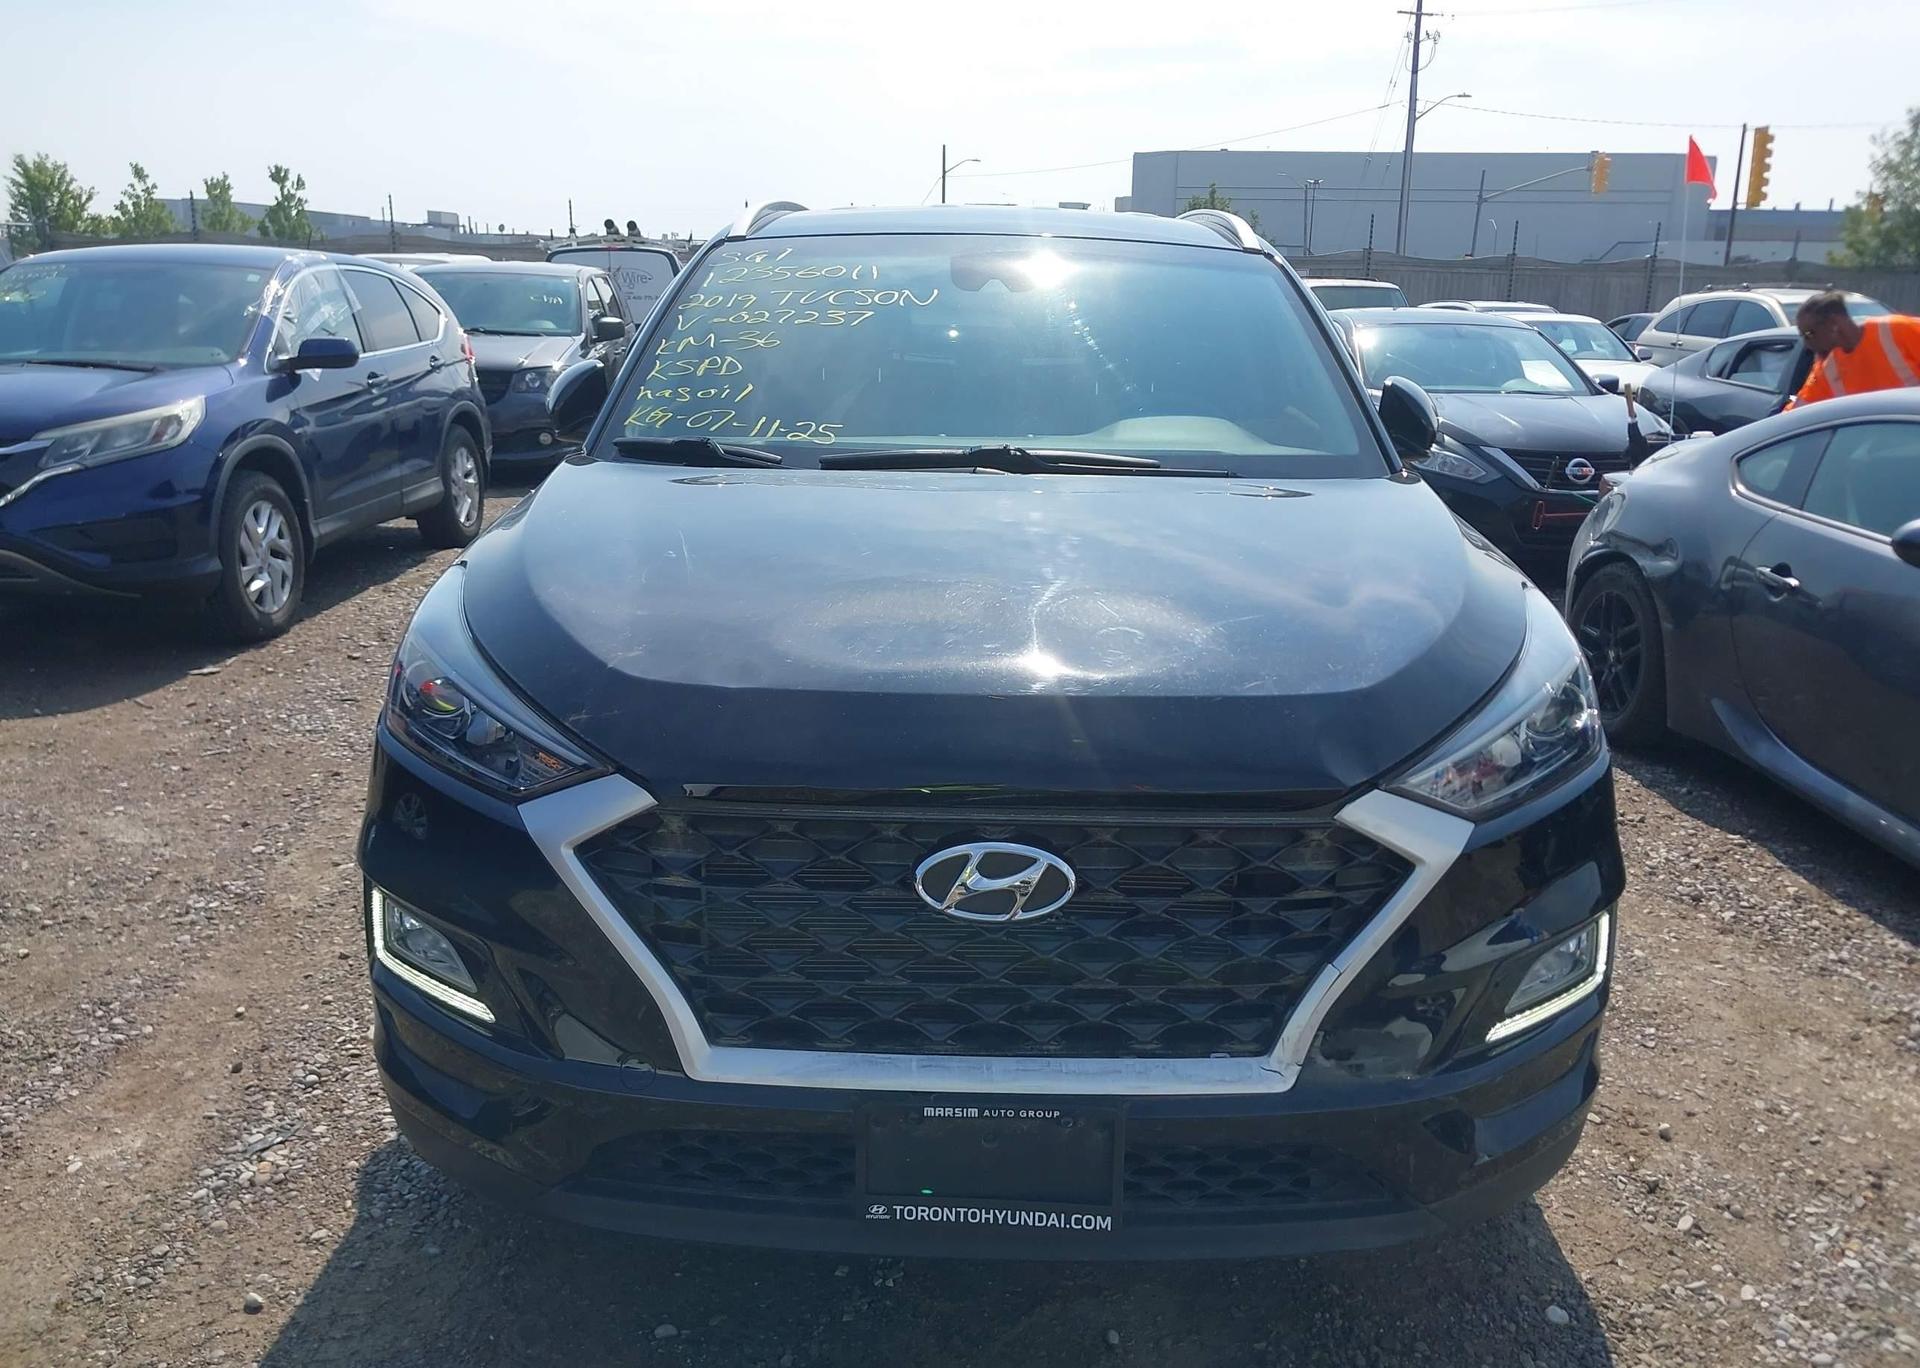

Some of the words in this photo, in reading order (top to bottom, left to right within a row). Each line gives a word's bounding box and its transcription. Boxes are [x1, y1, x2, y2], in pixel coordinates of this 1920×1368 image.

[678, 293, 757, 310] 2019
[770, 288, 938, 307] TUCSON
[923, 1106, 979, 1118] MARSIM
[983, 1109, 1015, 1118] AUTO
[1019, 1110, 1061, 1119] GROUP
[892, 1205, 1112, 1231] TORONTOHYUNDAI.COM
